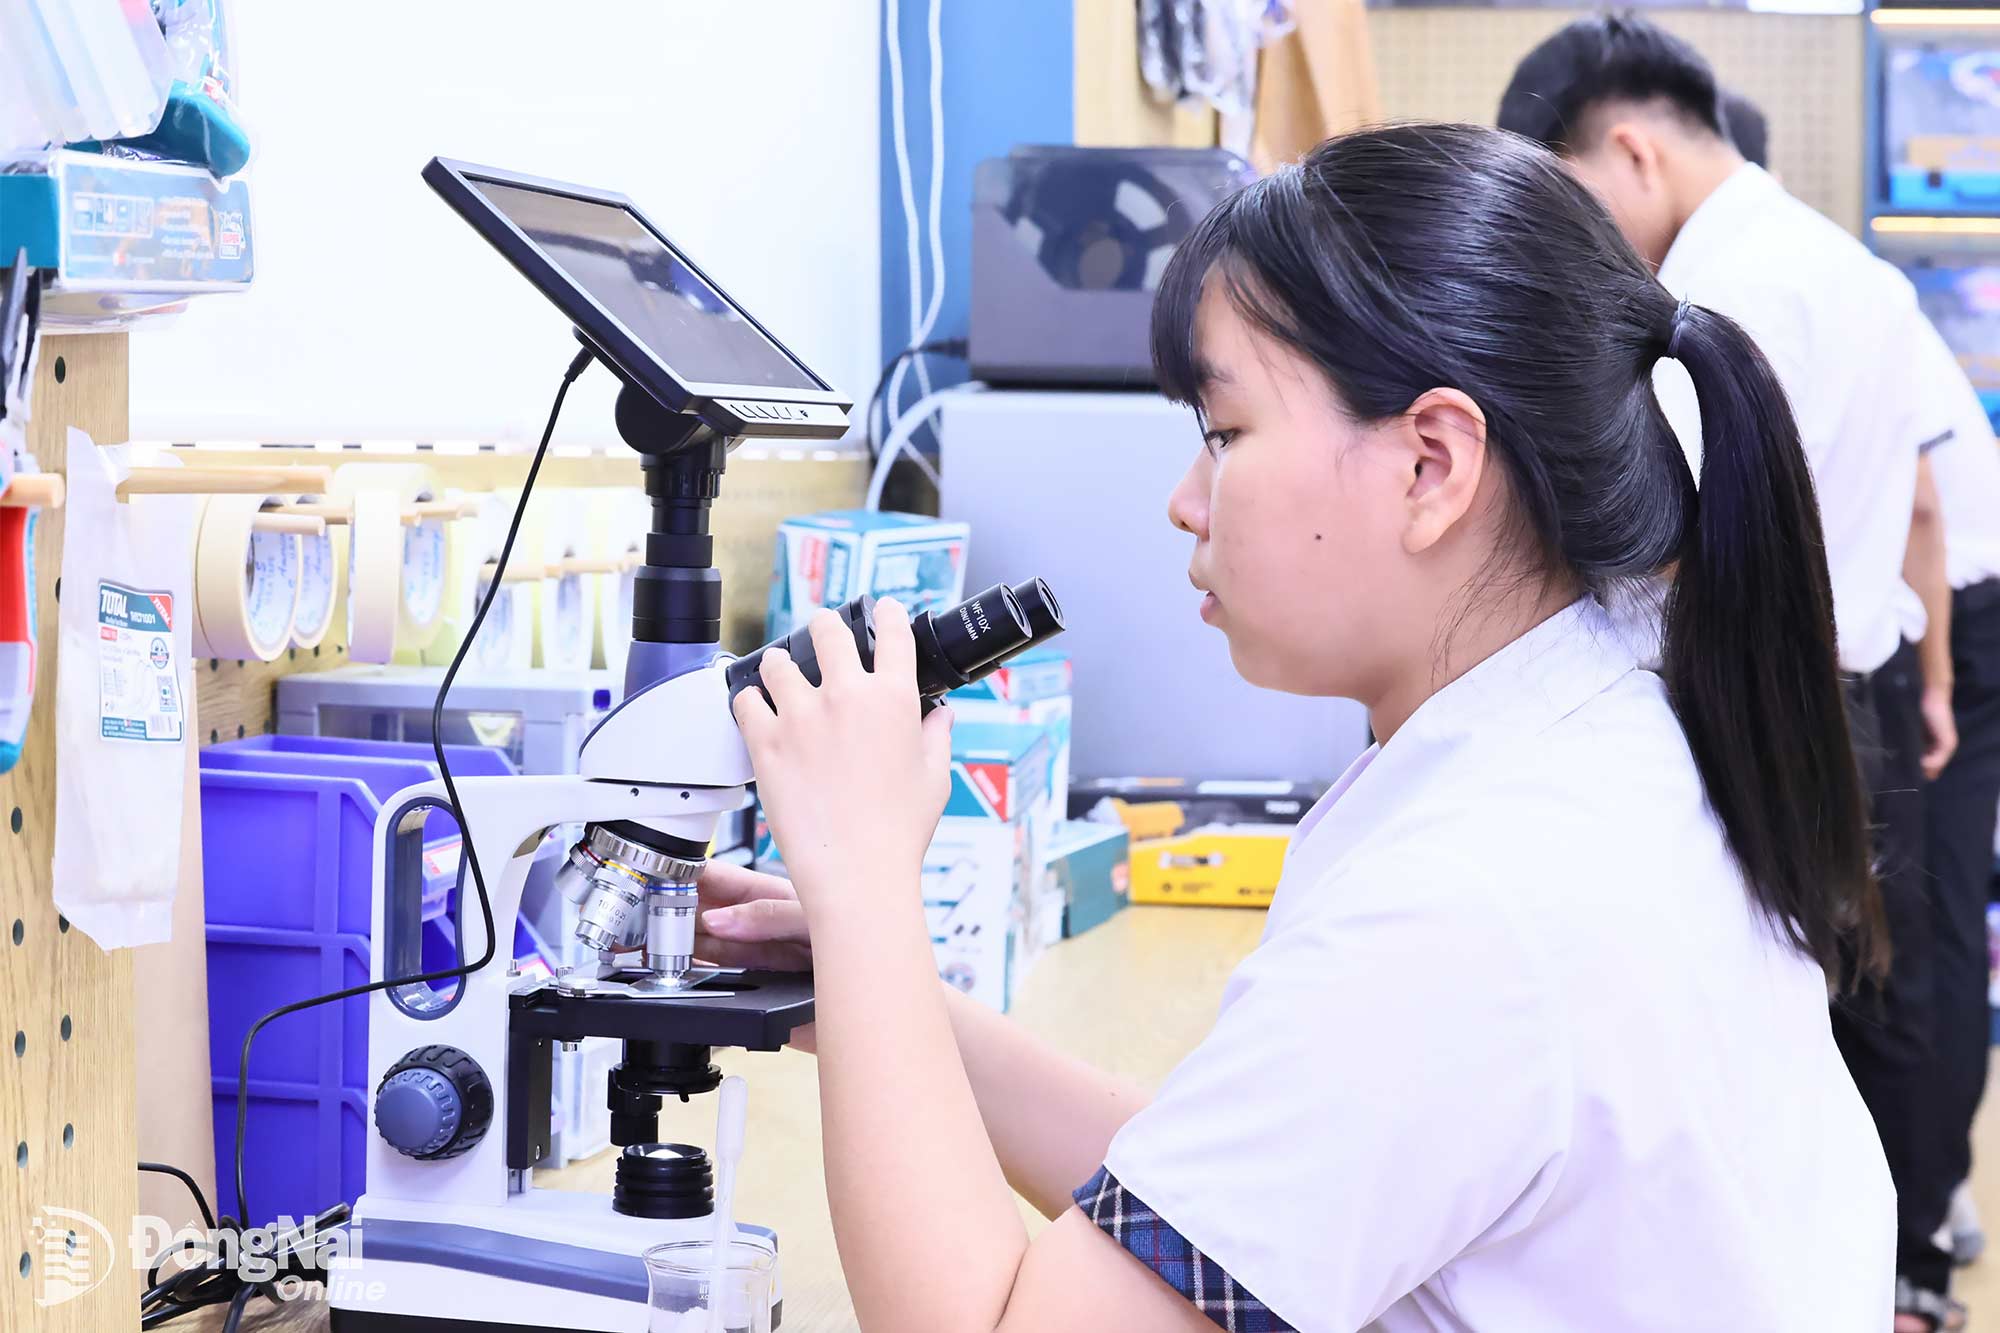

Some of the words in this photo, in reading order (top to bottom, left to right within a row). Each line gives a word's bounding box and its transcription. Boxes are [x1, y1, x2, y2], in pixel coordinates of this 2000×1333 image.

[101, 589, 128, 618] TOTAL
[971, 600, 991, 633] WF10X
[960, 606, 978, 640] DIN/18MM
